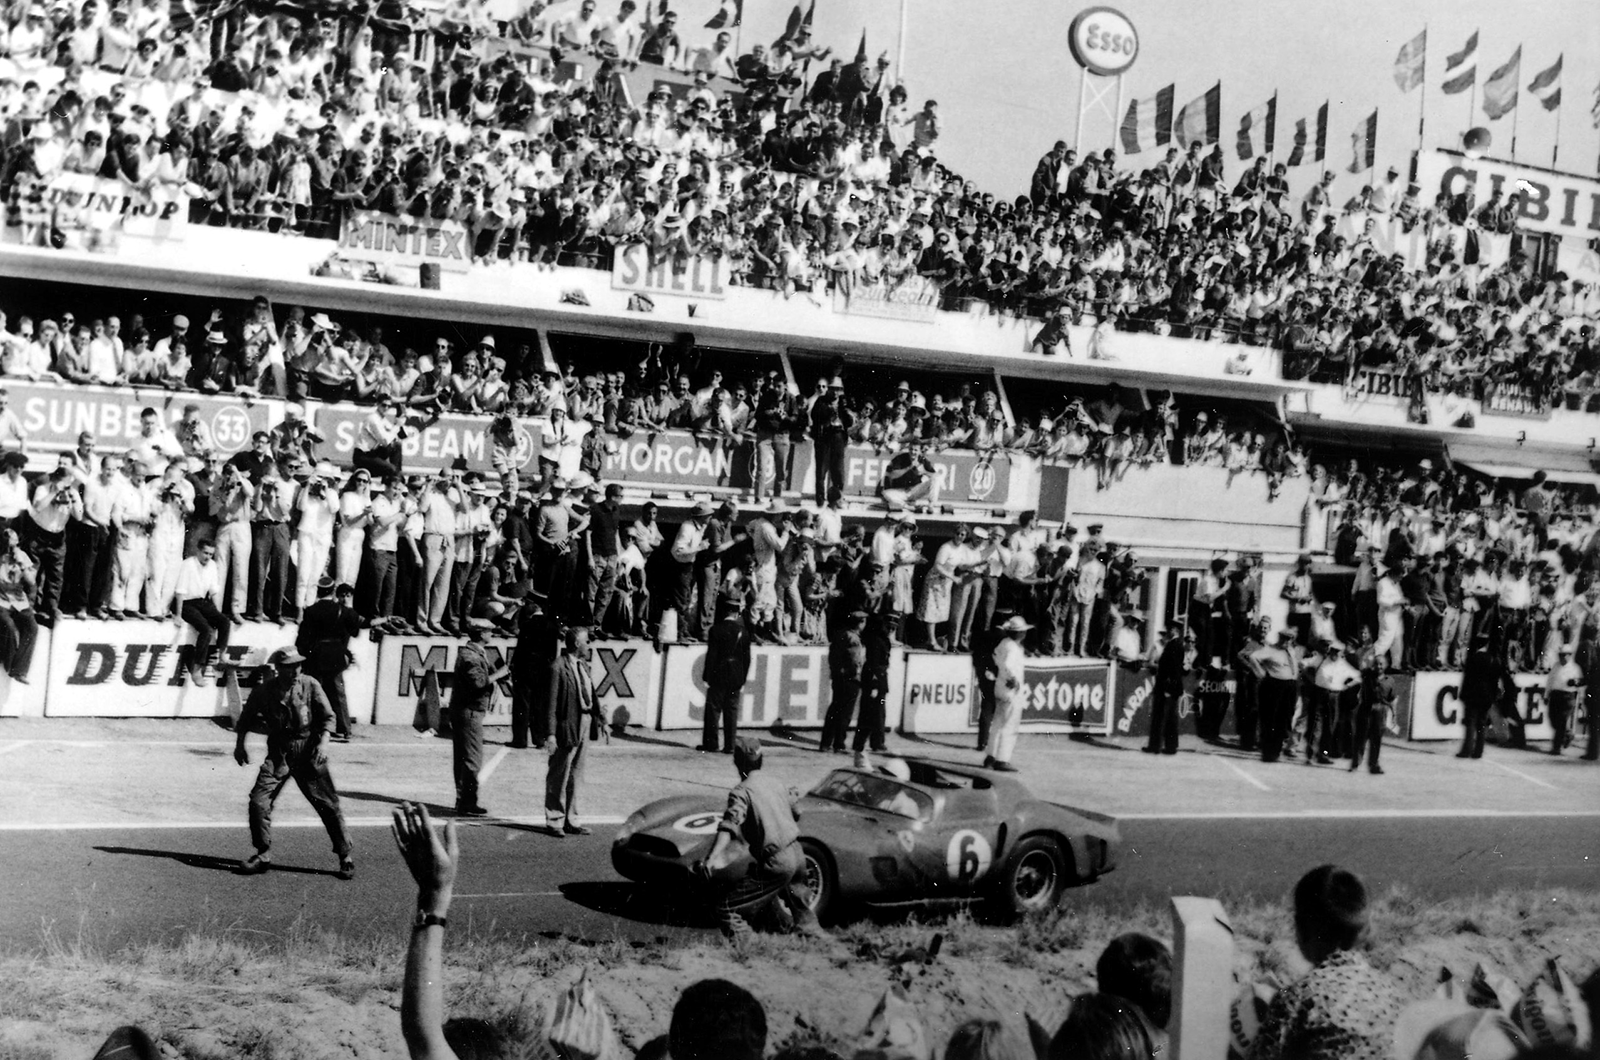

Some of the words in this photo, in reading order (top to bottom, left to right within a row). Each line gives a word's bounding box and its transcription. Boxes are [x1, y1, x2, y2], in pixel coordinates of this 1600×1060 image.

[349, 220, 465, 260] MINTEX
[217, 414, 245, 442] 33
[334, 420, 486, 462] SBEAM
[606, 440, 734, 478] MORGAN
[848, 458, 956, 491] FERI
[974, 467, 993, 490] 20
[909, 683, 967, 705] PNEUS
[1021, 674, 1105, 712] estone
[958, 835, 979, 881] 6
